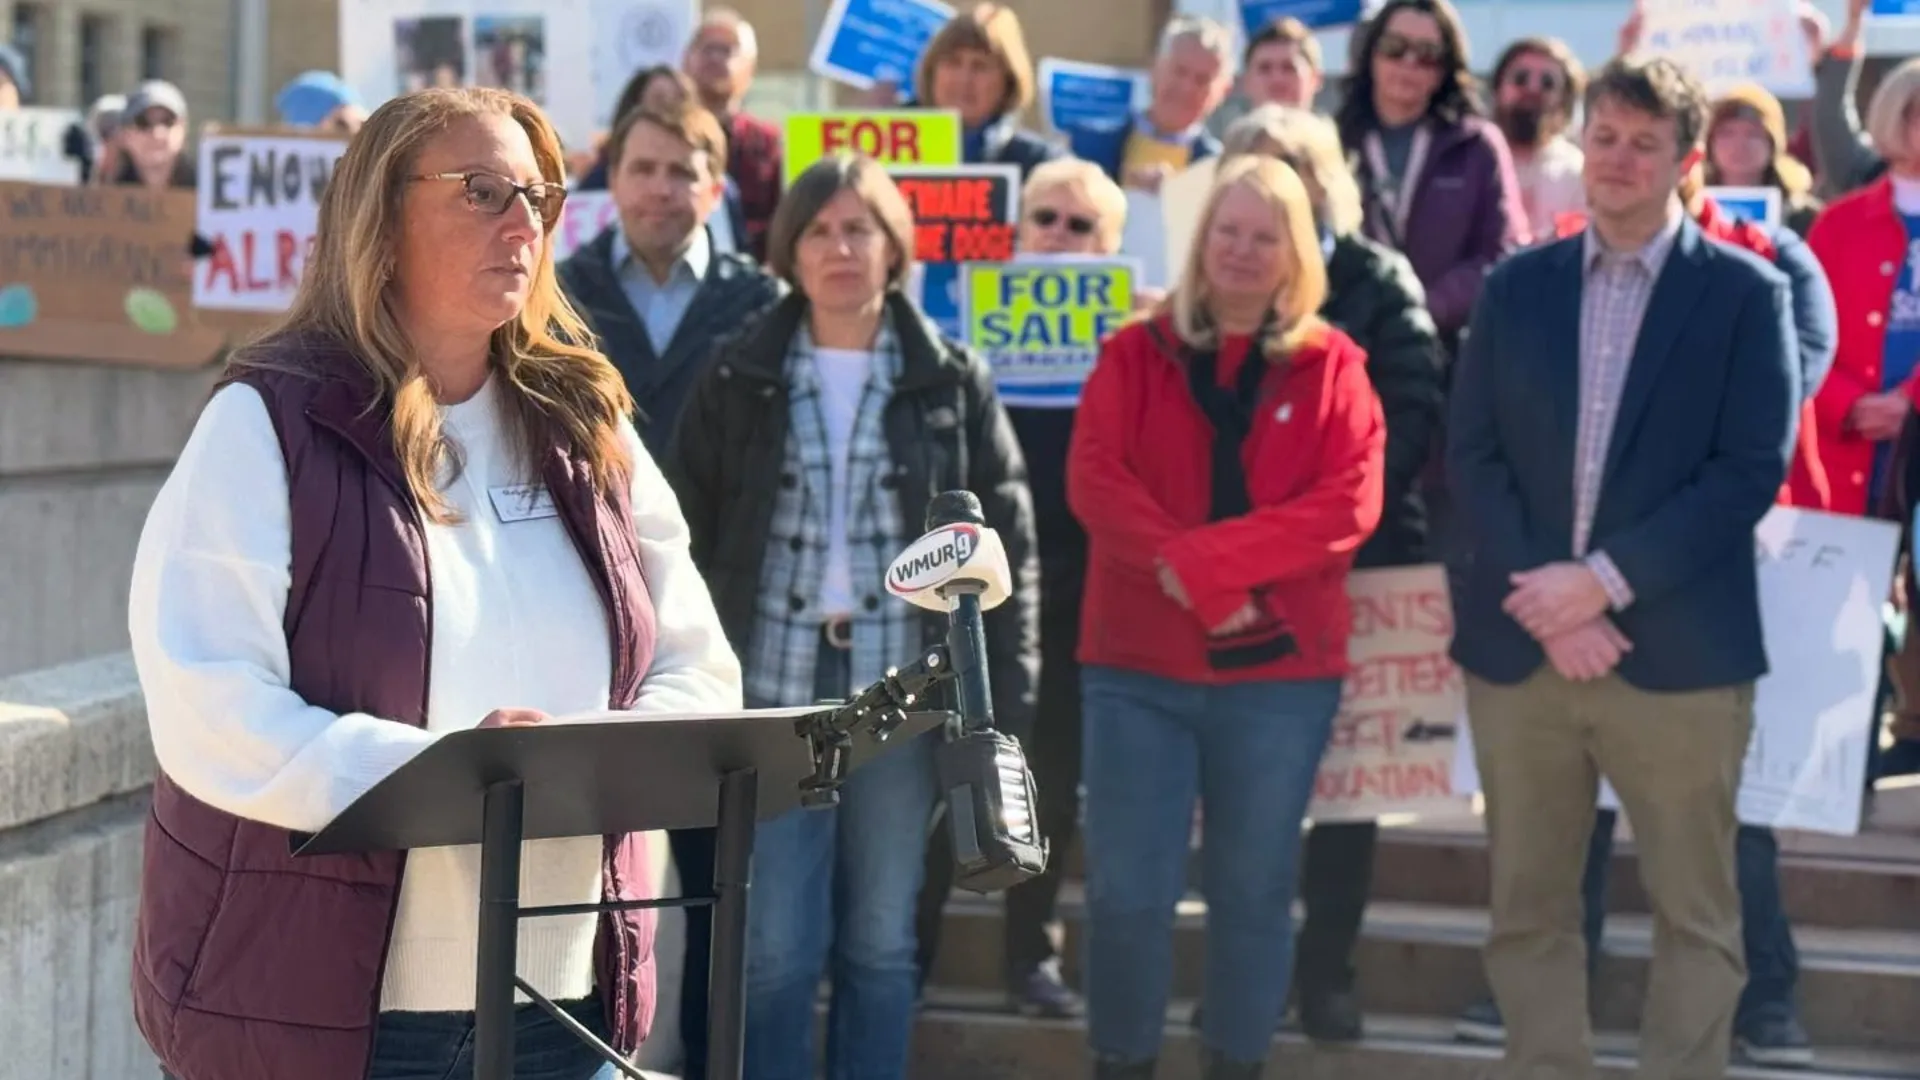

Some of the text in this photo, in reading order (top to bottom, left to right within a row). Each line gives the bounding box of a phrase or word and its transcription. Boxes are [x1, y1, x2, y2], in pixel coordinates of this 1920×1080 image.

[820, 119, 921, 163] FOR
[205, 231, 316, 292] ALR
[999, 272, 1112, 308] FOR
